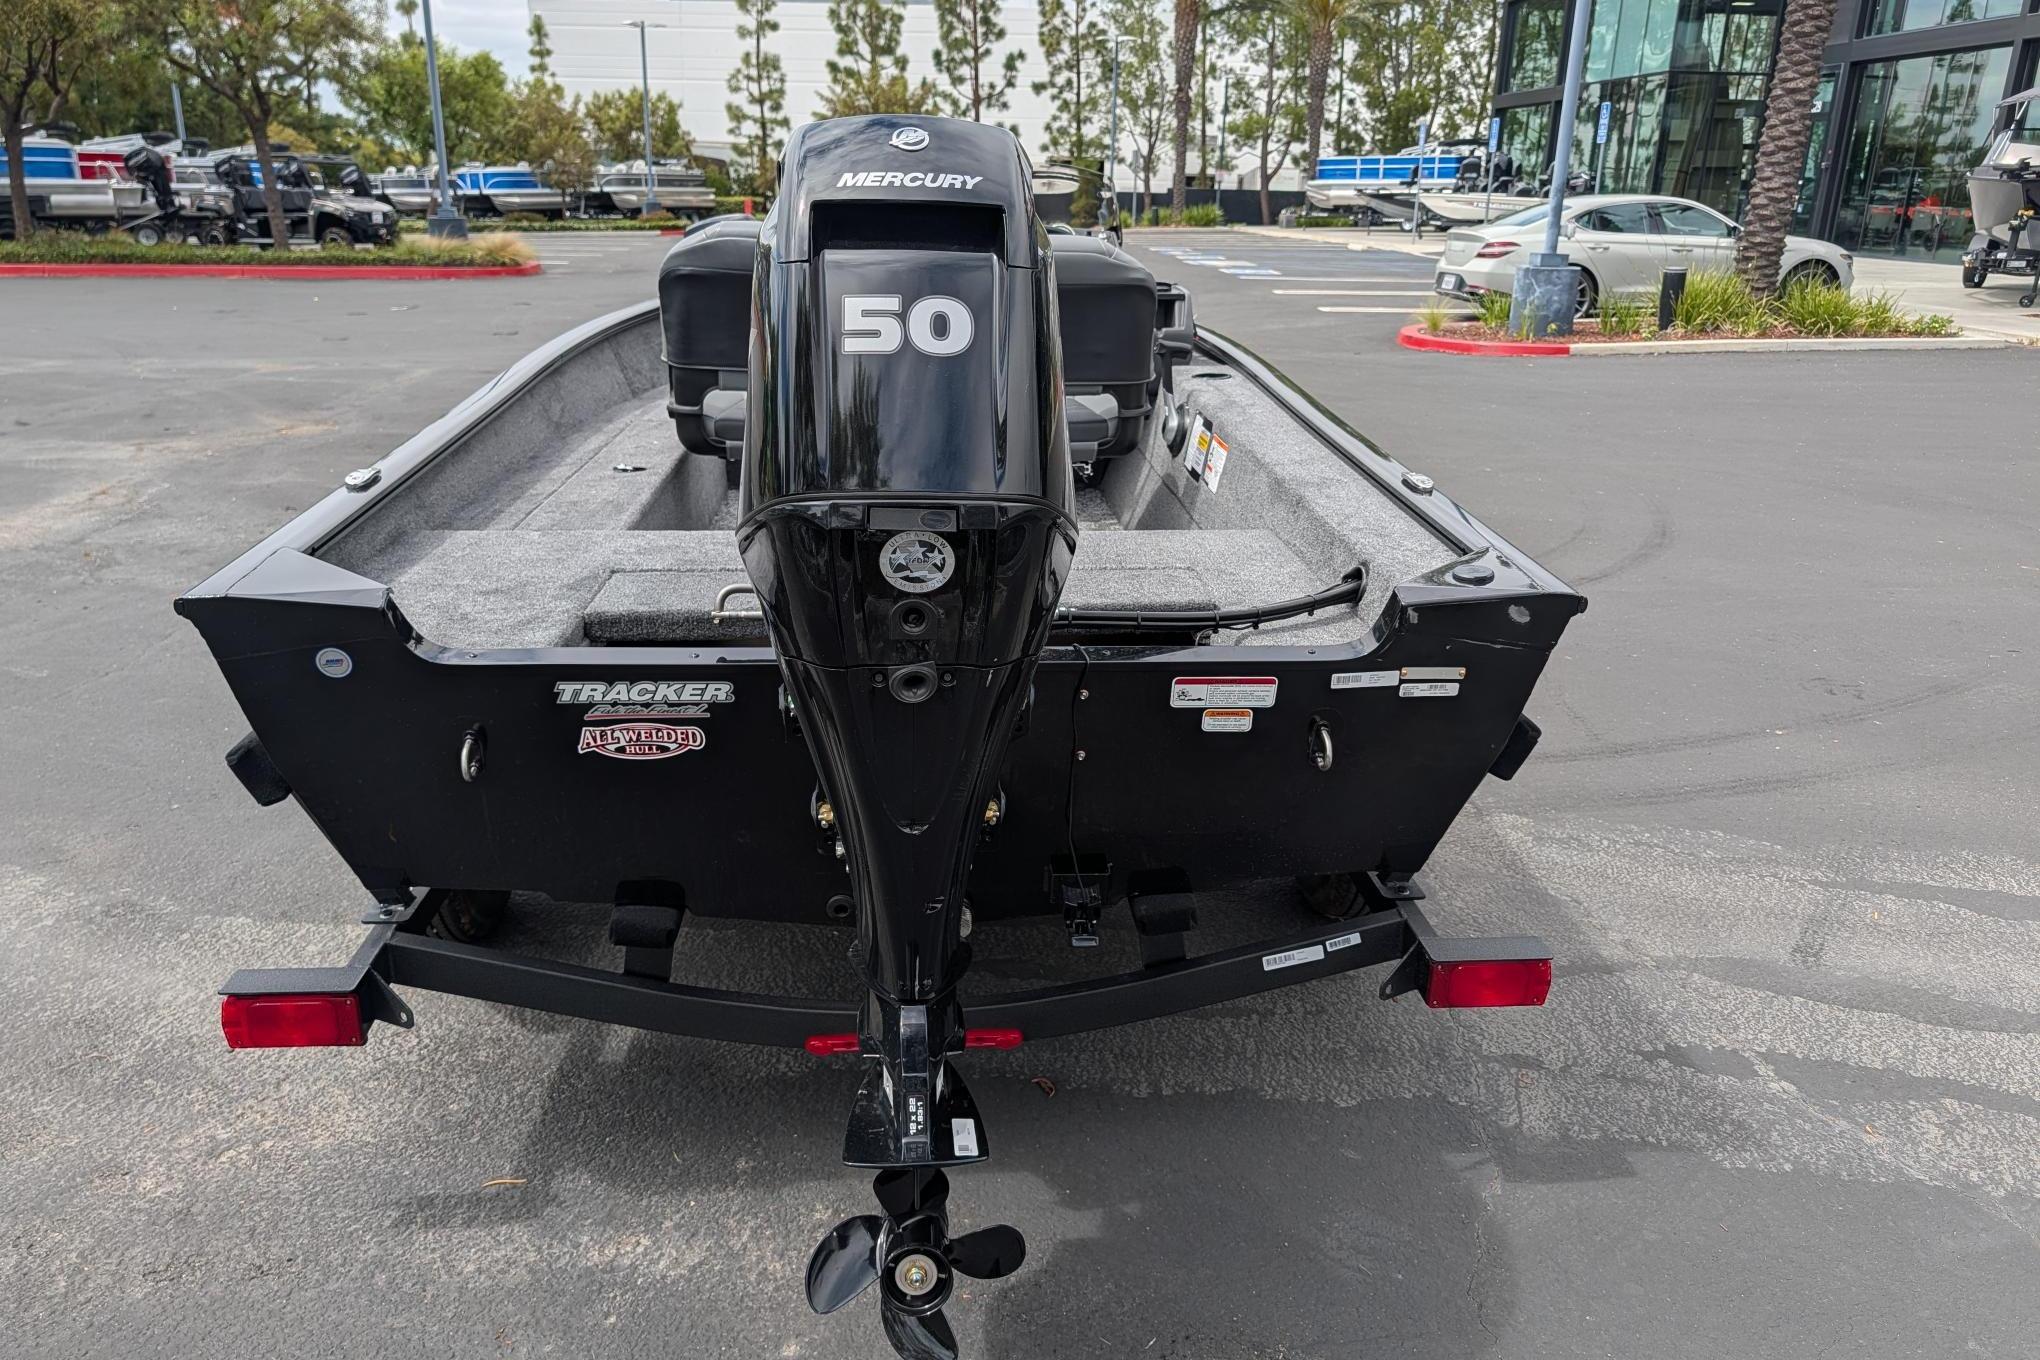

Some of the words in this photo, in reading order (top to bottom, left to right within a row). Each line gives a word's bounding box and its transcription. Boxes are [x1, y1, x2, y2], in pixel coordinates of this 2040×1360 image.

[836, 171, 983, 190] MERCURY
[842, 294, 975, 357] 50
[888, 532, 920, 549] ULTRA
[927, 534, 948, 549] LOW
[554, 681, 735, 704] TRACKER
[582, 729, 620, 748] ALL
[619, 728, 702, 746] WELDED
[625, 745, 661, 754] HULL
[909, 1097, 916, 1112] 22
[909, 1122, 917, 1136] 12
